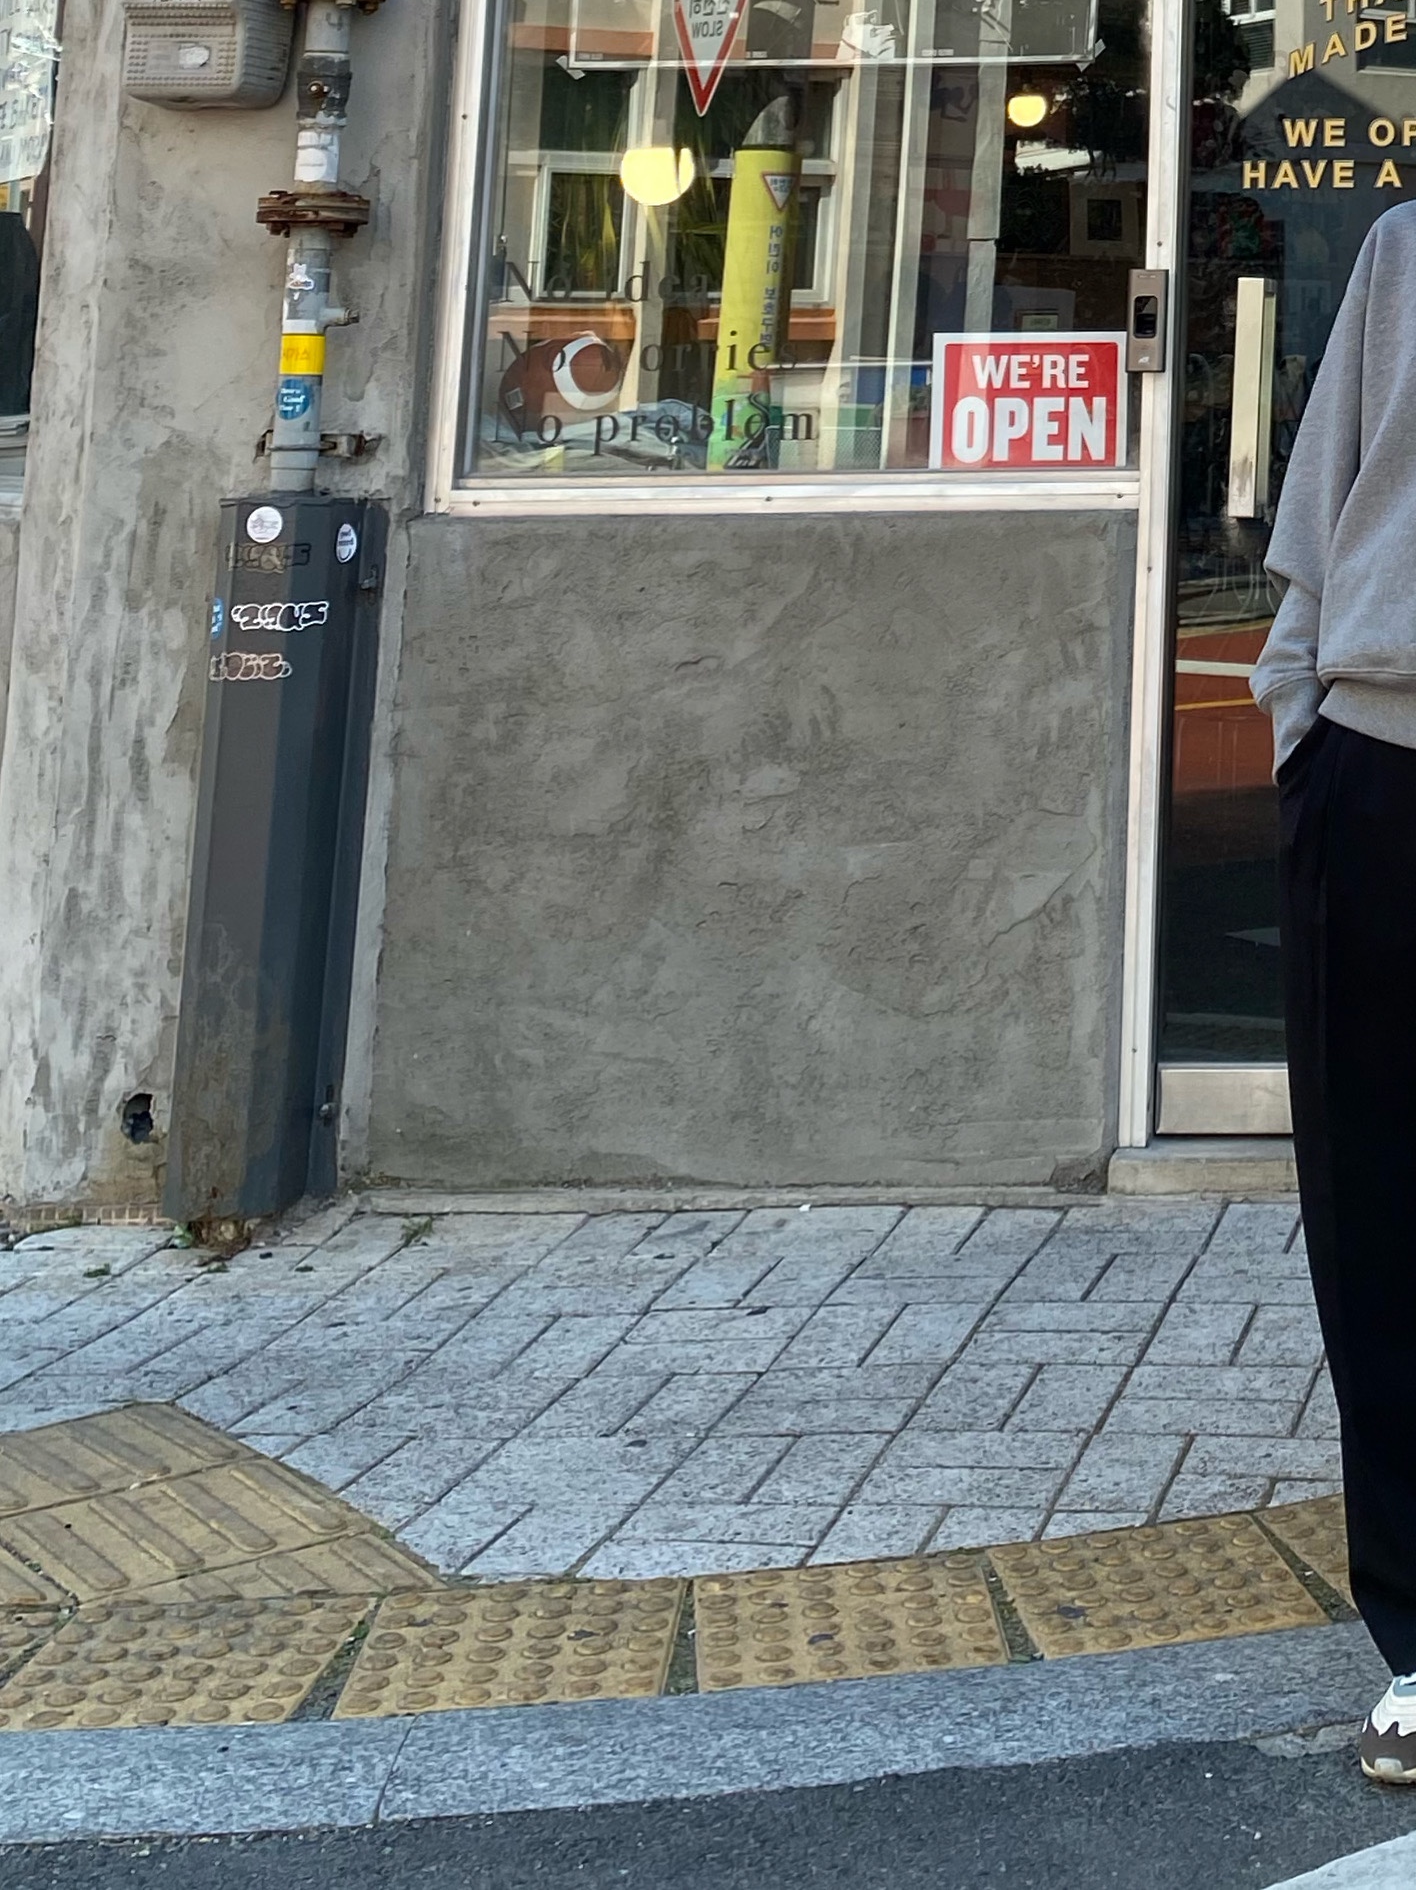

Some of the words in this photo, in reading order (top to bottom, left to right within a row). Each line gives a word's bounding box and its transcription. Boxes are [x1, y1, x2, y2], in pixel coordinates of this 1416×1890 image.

[1287, 11, 1409, 81] MADE
[1282, 117, 1346, 148] WE
[1241, 159, 1356, 190] HAVE
[1375, 158, 1403, 189] A
[504, 260, 573, 303] No
[603, 260, 713, 303] idea
[496, 330, 567, 373] No
[598, 329, 799, 373] worries
[493, 398, 564, 443] No
[590, 397, 820, 457] problem
[951, 395, 1107, 464] OPEN
